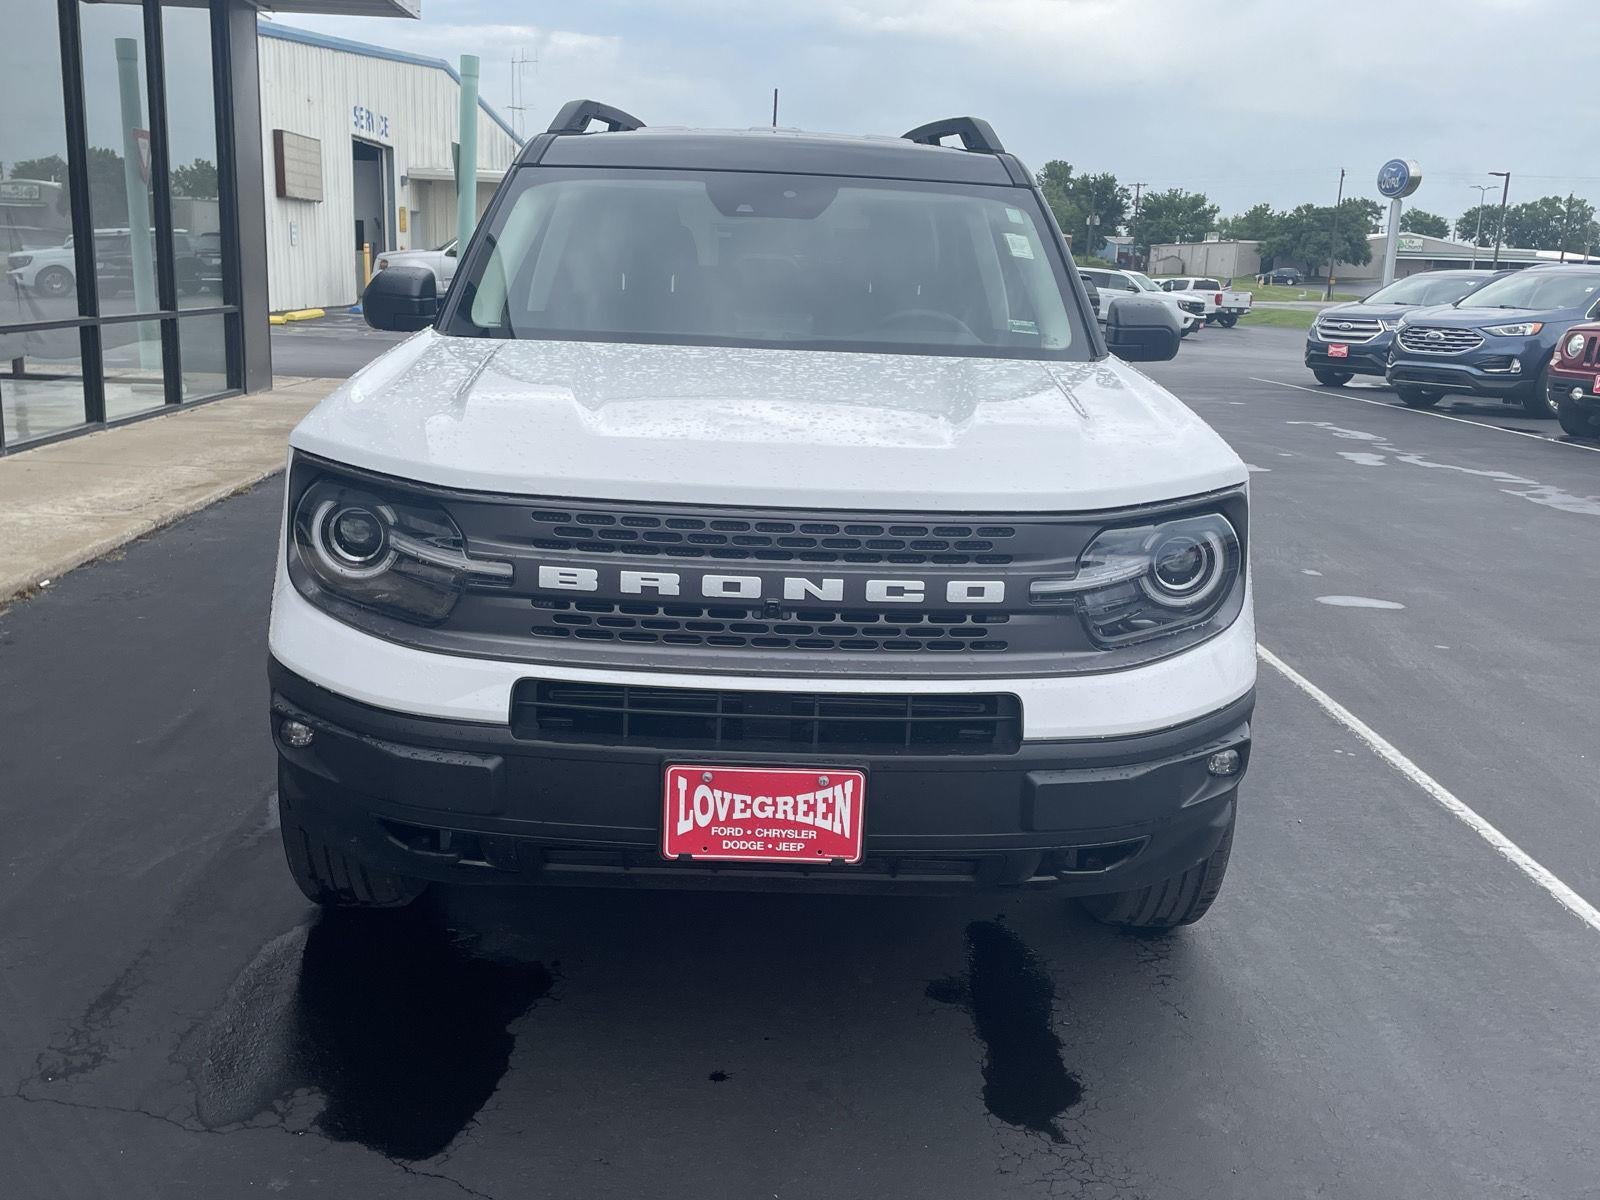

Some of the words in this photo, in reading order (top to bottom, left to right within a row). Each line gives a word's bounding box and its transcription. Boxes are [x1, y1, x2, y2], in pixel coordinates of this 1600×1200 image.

[353, 105, 388, 138] SERVCE
[1381, 167, 1402, 189] Ford
[538, 565, 1006, 603] BRONCO
[677, 775, 854, 839] LOVEGREEN
[711, 826, 744, 836] FORD
[755, 828, 817, 839] CHRYSLER
[722, 840, 764, 851] DODGE
[775, 842, 805, 852] JEEP
